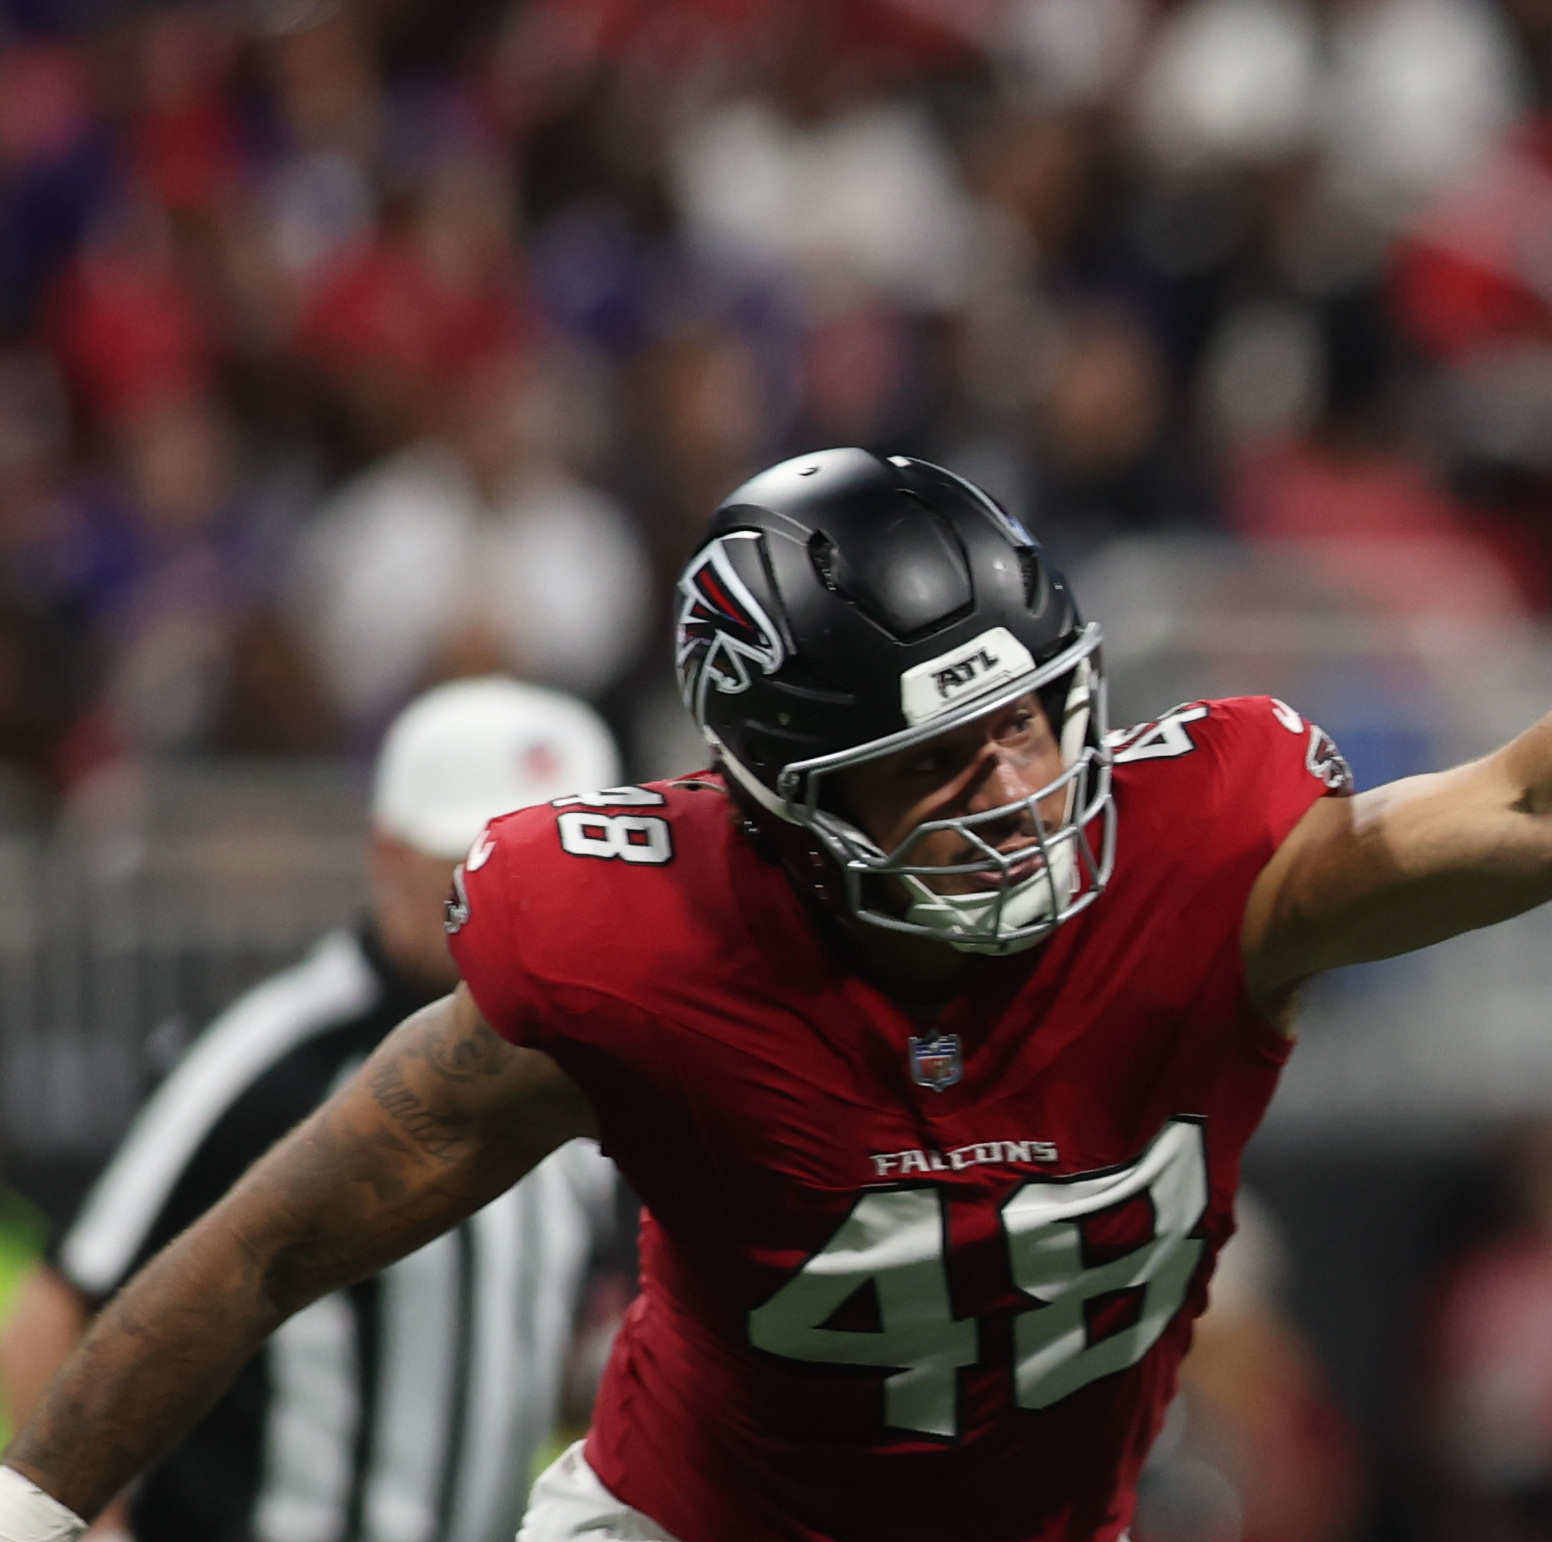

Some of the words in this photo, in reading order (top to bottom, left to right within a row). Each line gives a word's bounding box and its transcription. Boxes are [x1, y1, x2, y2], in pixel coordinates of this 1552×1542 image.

[930, 648, 999, 699] ATL
[869, 1140, 1059, 1176] FALCONS
[746, 1114, 1209, 1443] 48
